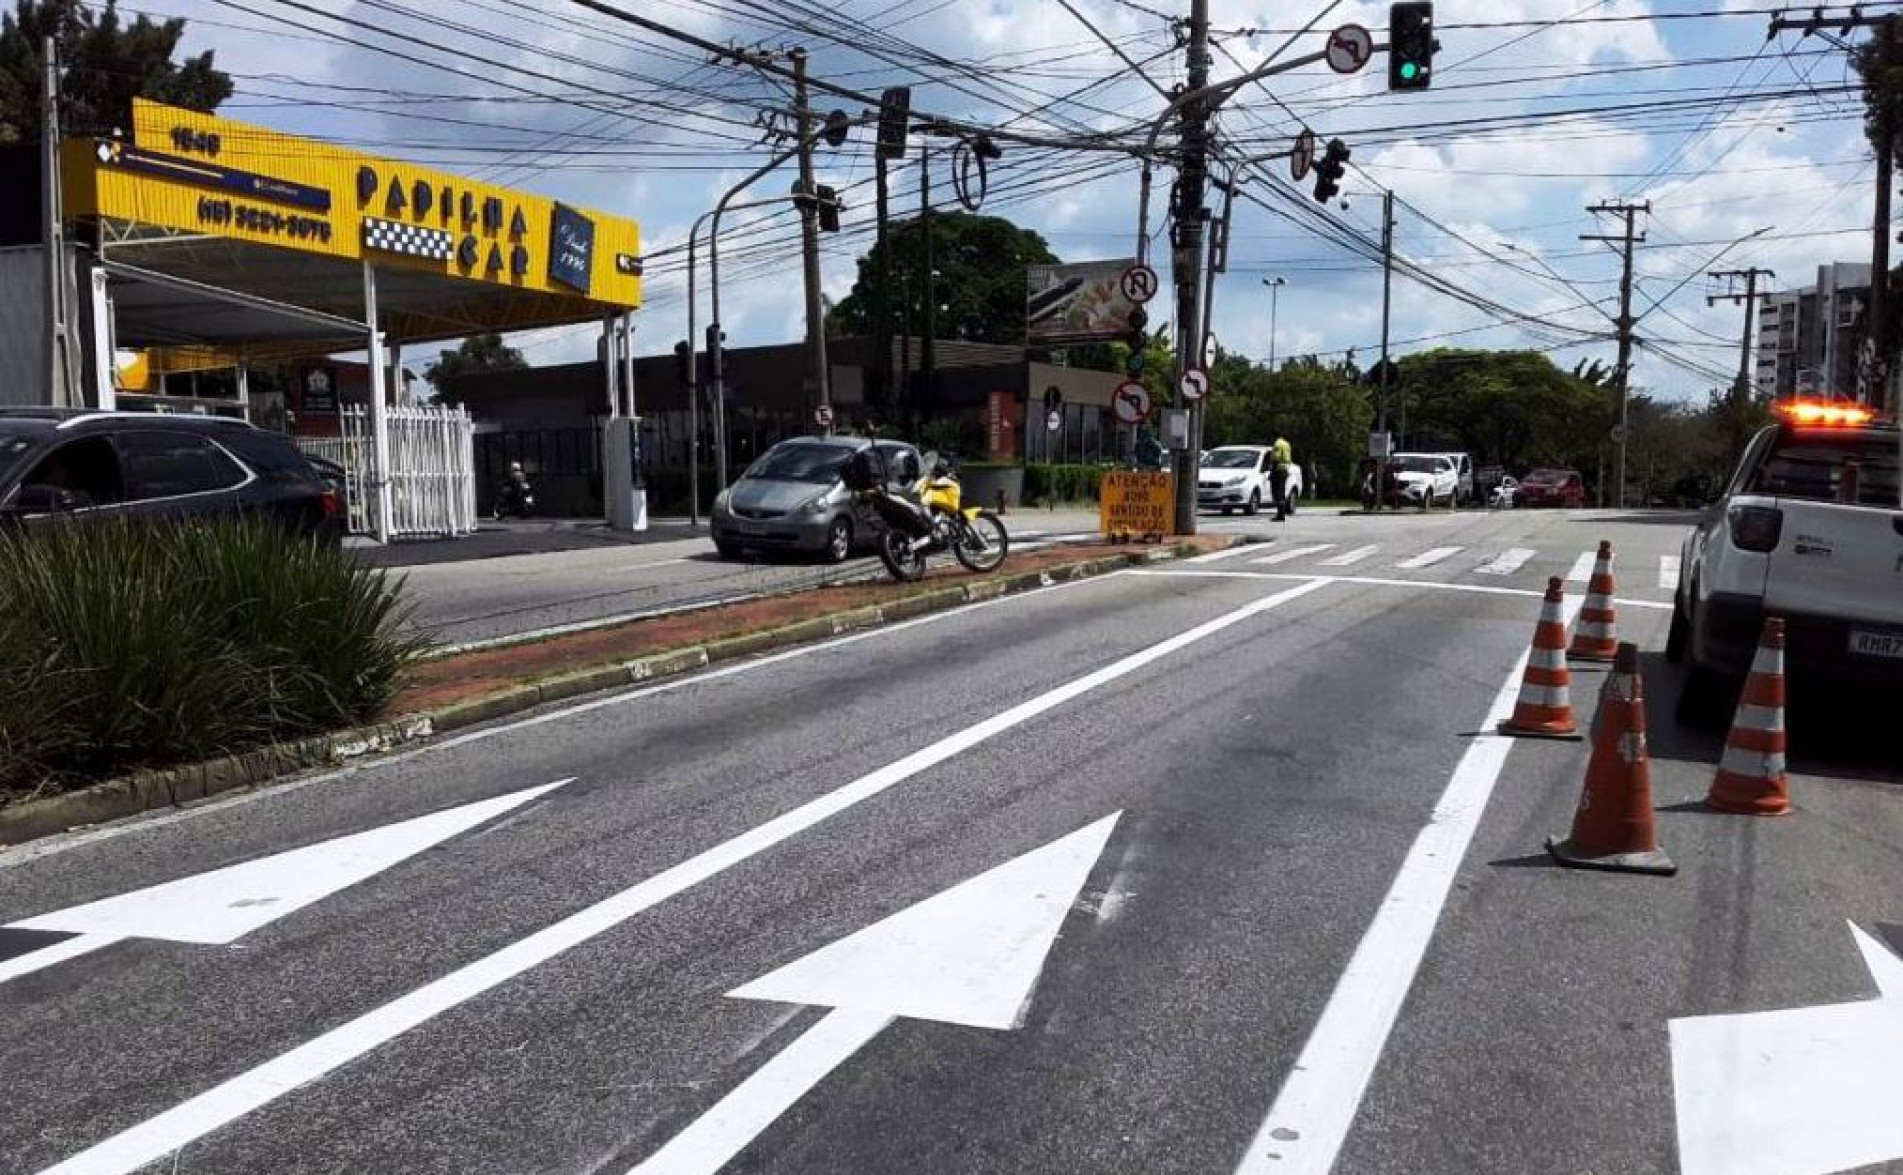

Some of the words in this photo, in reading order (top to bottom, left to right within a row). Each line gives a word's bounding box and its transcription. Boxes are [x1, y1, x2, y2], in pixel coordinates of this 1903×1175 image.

[358, 166, 527, 237] PADILHA
[459, 235, 528, 277] CAR
[1108, 474, 1167, 489] ATENÇÃO
[1109, 504, 1148, 516] SENTIDO
[1151, 505, 1163, 516] DE
